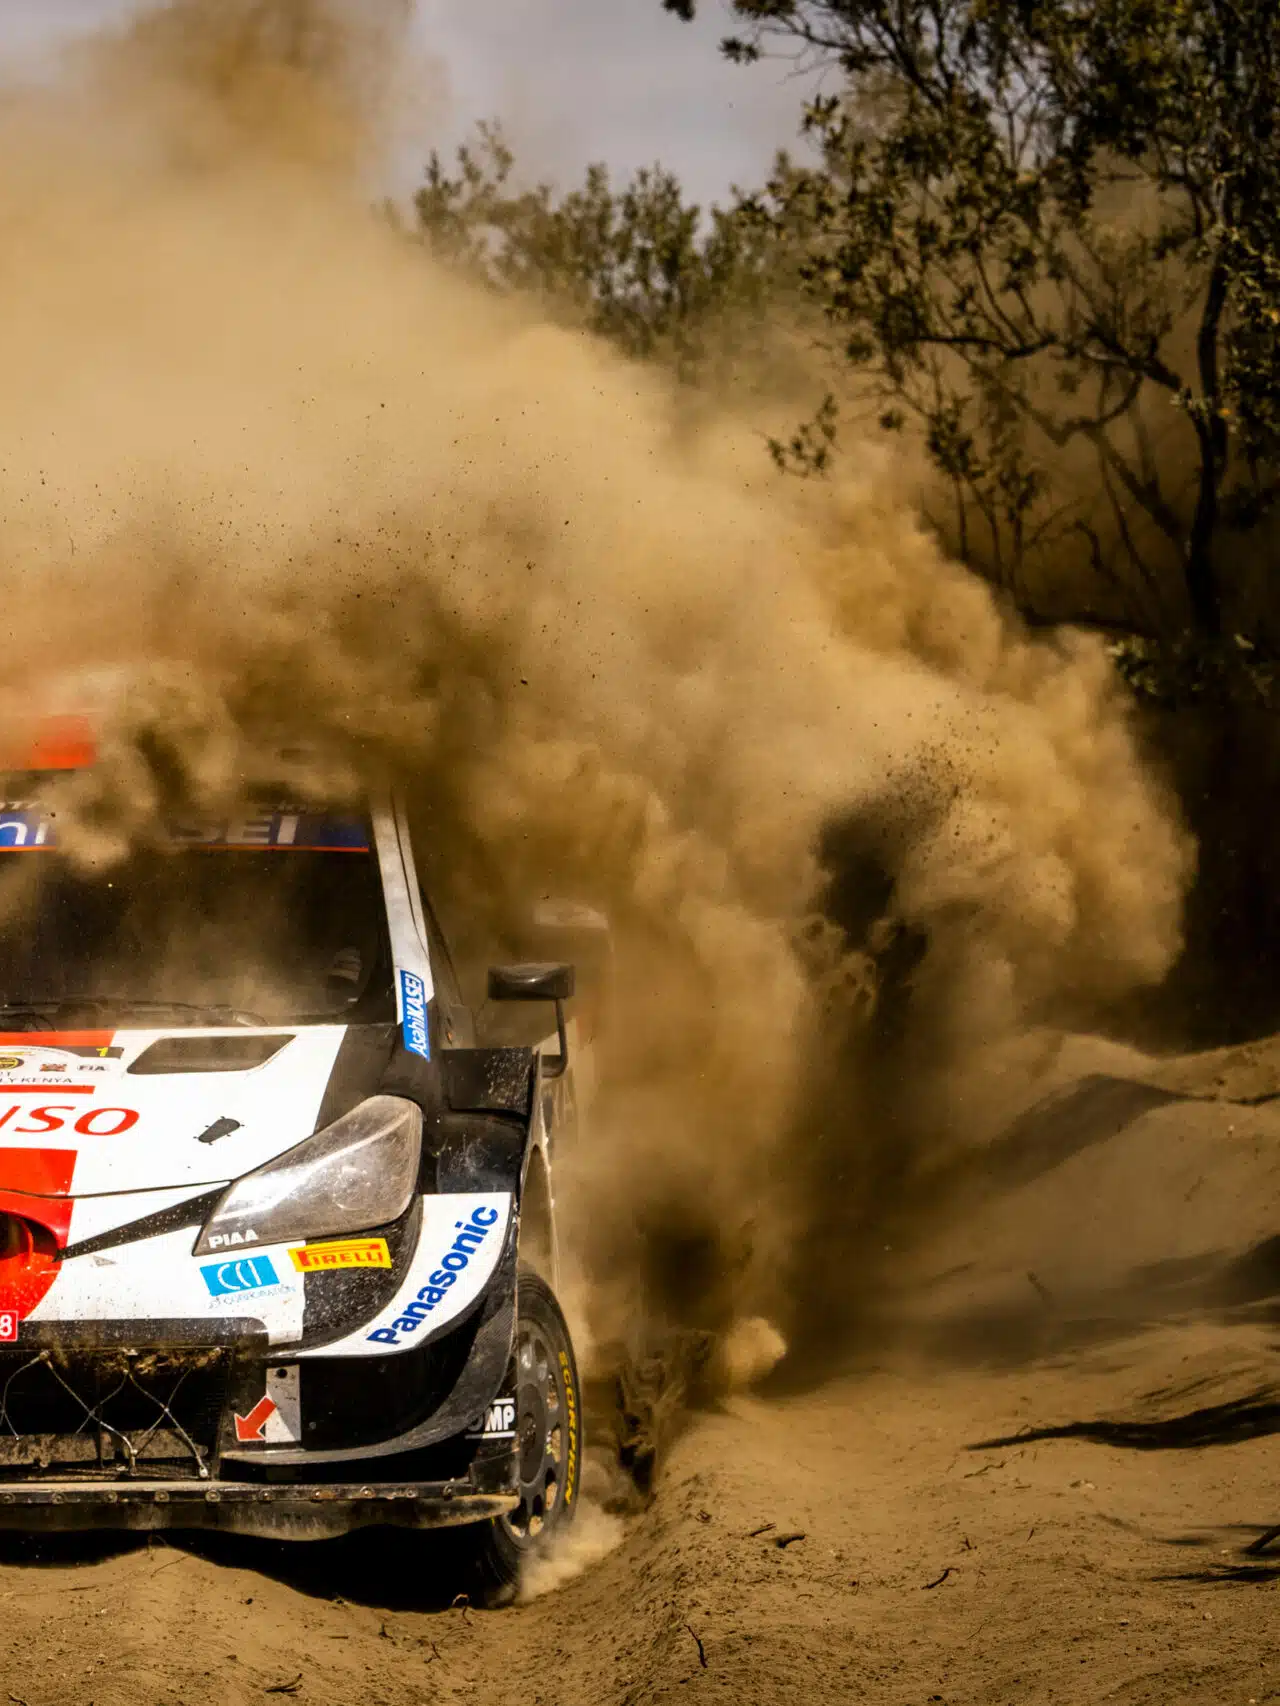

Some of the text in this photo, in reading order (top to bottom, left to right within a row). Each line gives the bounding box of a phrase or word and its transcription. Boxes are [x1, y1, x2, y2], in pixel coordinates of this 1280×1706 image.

[96, 1047, 109, 1057] 1
[78, 1063, 106, 1072] FIA
[21, 1076, 73, 1084] KENYA
[207, 1229, 259, 1248] PIAA
[296, 1243, 384, 1267] PIRELLI
[366, 1206, 498, 1345] Panasonic
[558, 1351, 577, 1505] SCORPION
